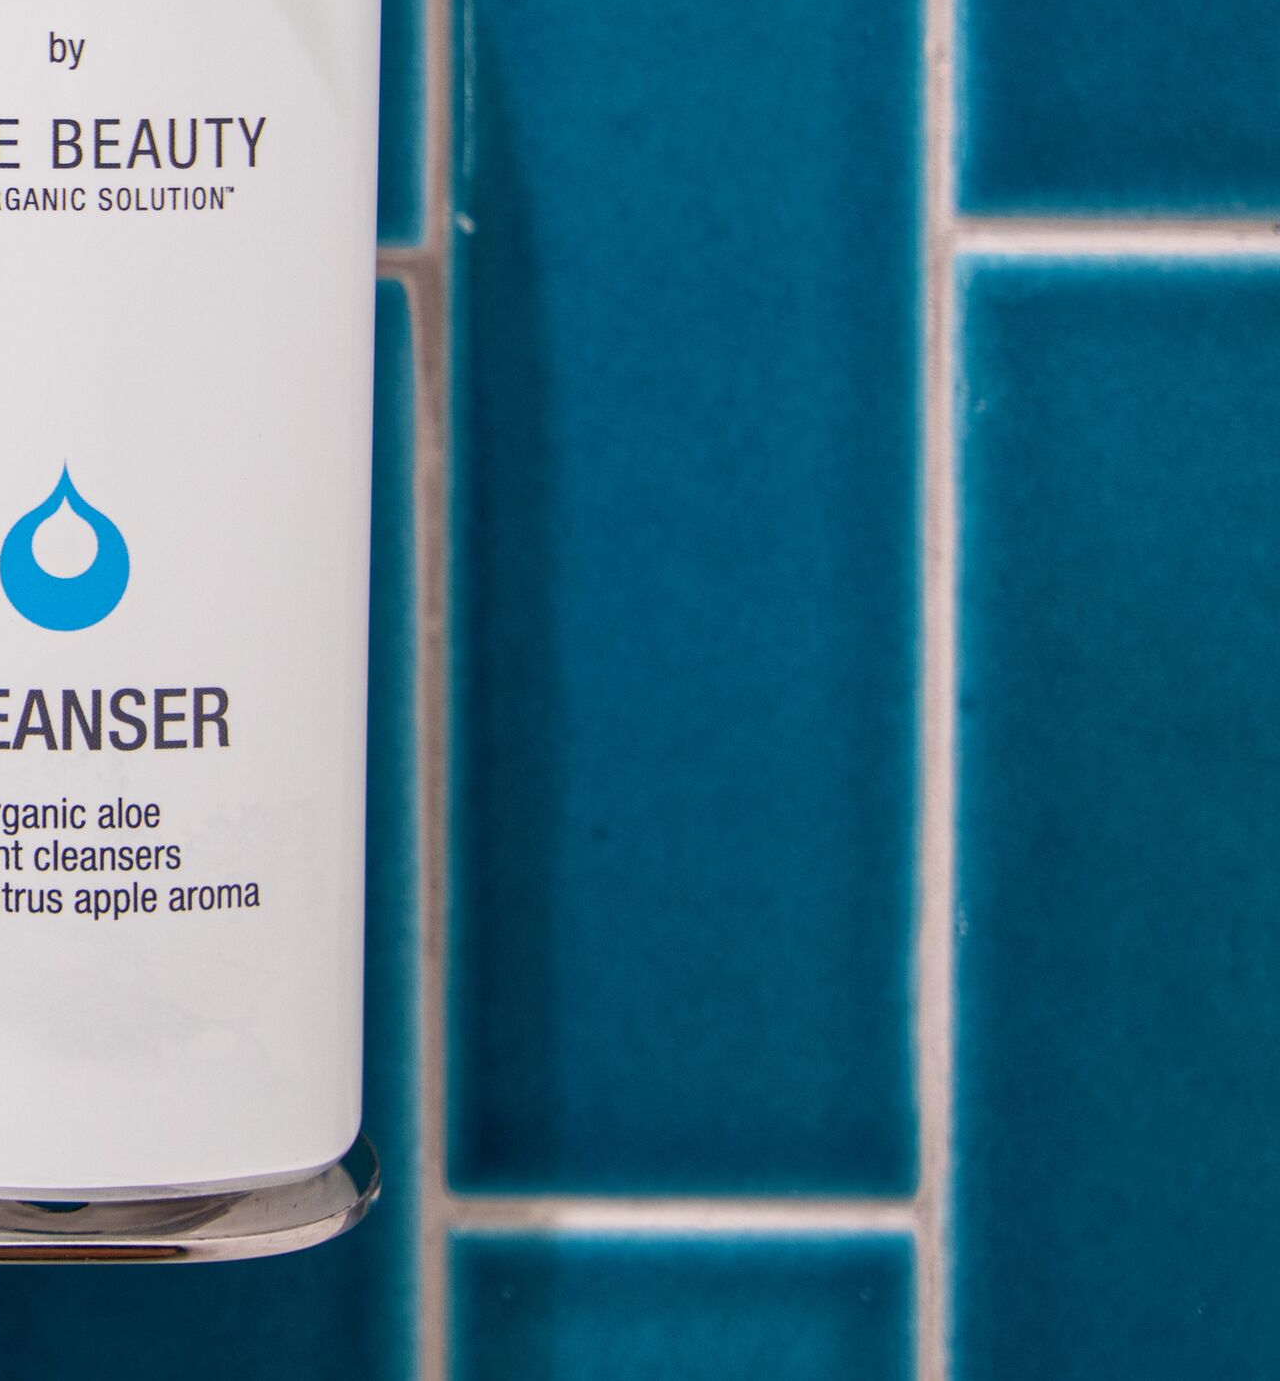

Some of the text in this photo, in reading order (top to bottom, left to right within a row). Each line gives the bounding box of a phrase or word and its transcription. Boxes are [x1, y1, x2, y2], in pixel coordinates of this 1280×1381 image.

[49, 31, 86, 71] by
[52, 116, 267, 170] BEAUTY
[97, 796, 161, 830] aloe
[33, 839, 182, 873] cleansers
[73, 881, 158, 922] apple
[168, 882, 261, 913] aroma
